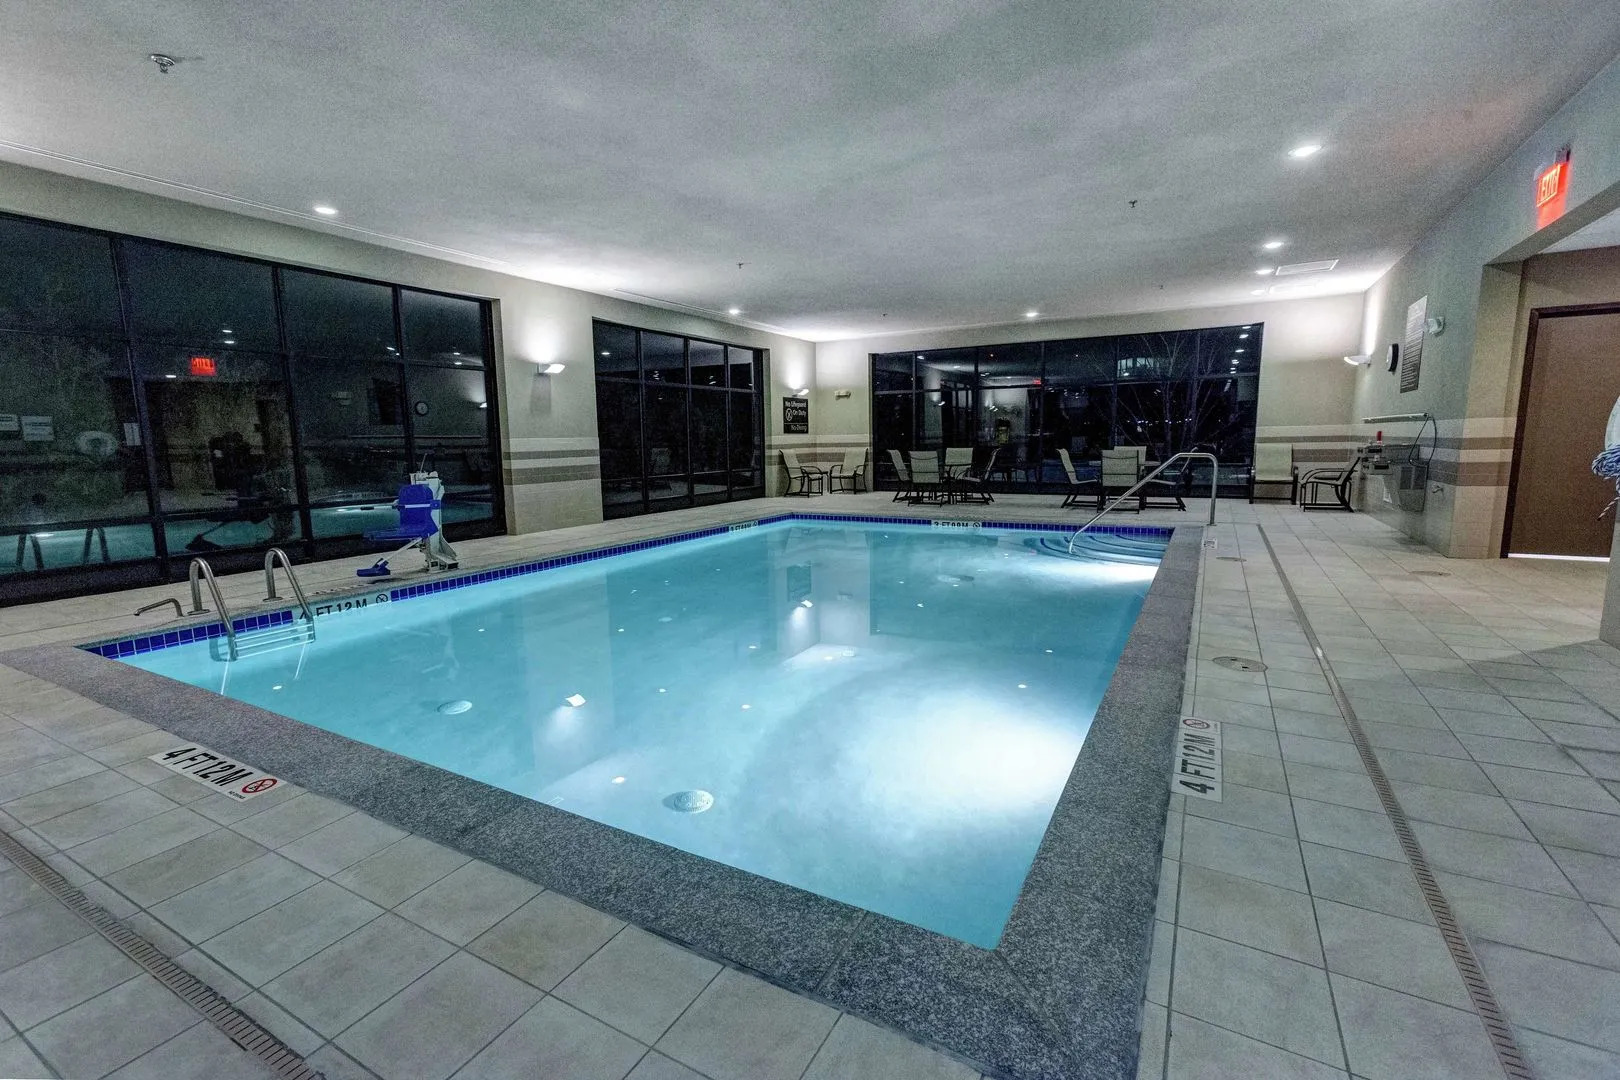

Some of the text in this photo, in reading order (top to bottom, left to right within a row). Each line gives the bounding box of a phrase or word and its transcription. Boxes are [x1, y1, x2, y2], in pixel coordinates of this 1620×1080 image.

[1184, 732, 1215, 747] M
[162, 747, 197, 760] 4
[173, 752, 219, 769] FT
[1181, 758, 1215, 780] FT
[210, 768, 253, 787] M
[1179, 780, 1215, 794] 4
